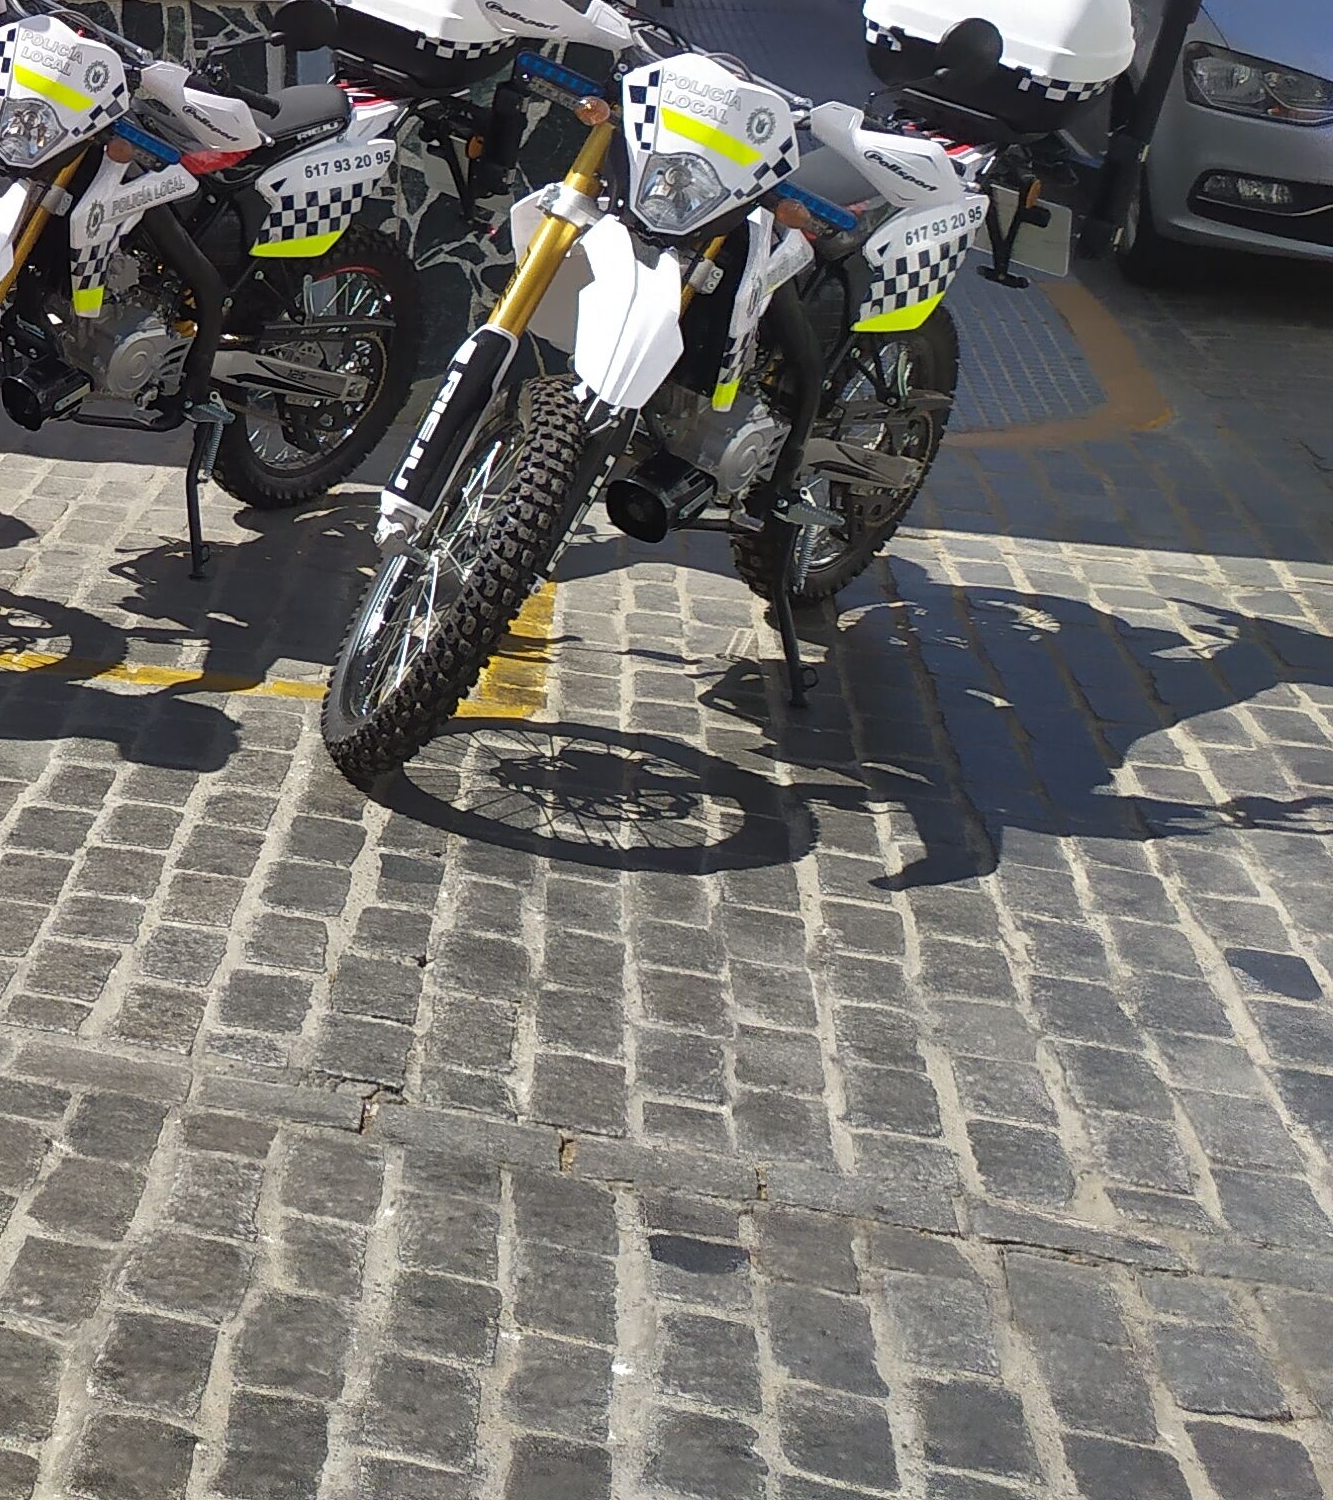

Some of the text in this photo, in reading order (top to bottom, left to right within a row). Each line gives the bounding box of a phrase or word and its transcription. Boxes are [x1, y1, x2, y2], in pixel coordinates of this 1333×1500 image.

[20, 46, 72, 77] LOCAL
[661, 70, 742, 112] POLICÍA
[662, 89, 729, 125] LOCAL
[304, 149, 392, 179] 617 93 20 95
[905, 205, 983, 246] 617 93 20 95
[394, 370, 463, 491] RIEJU
